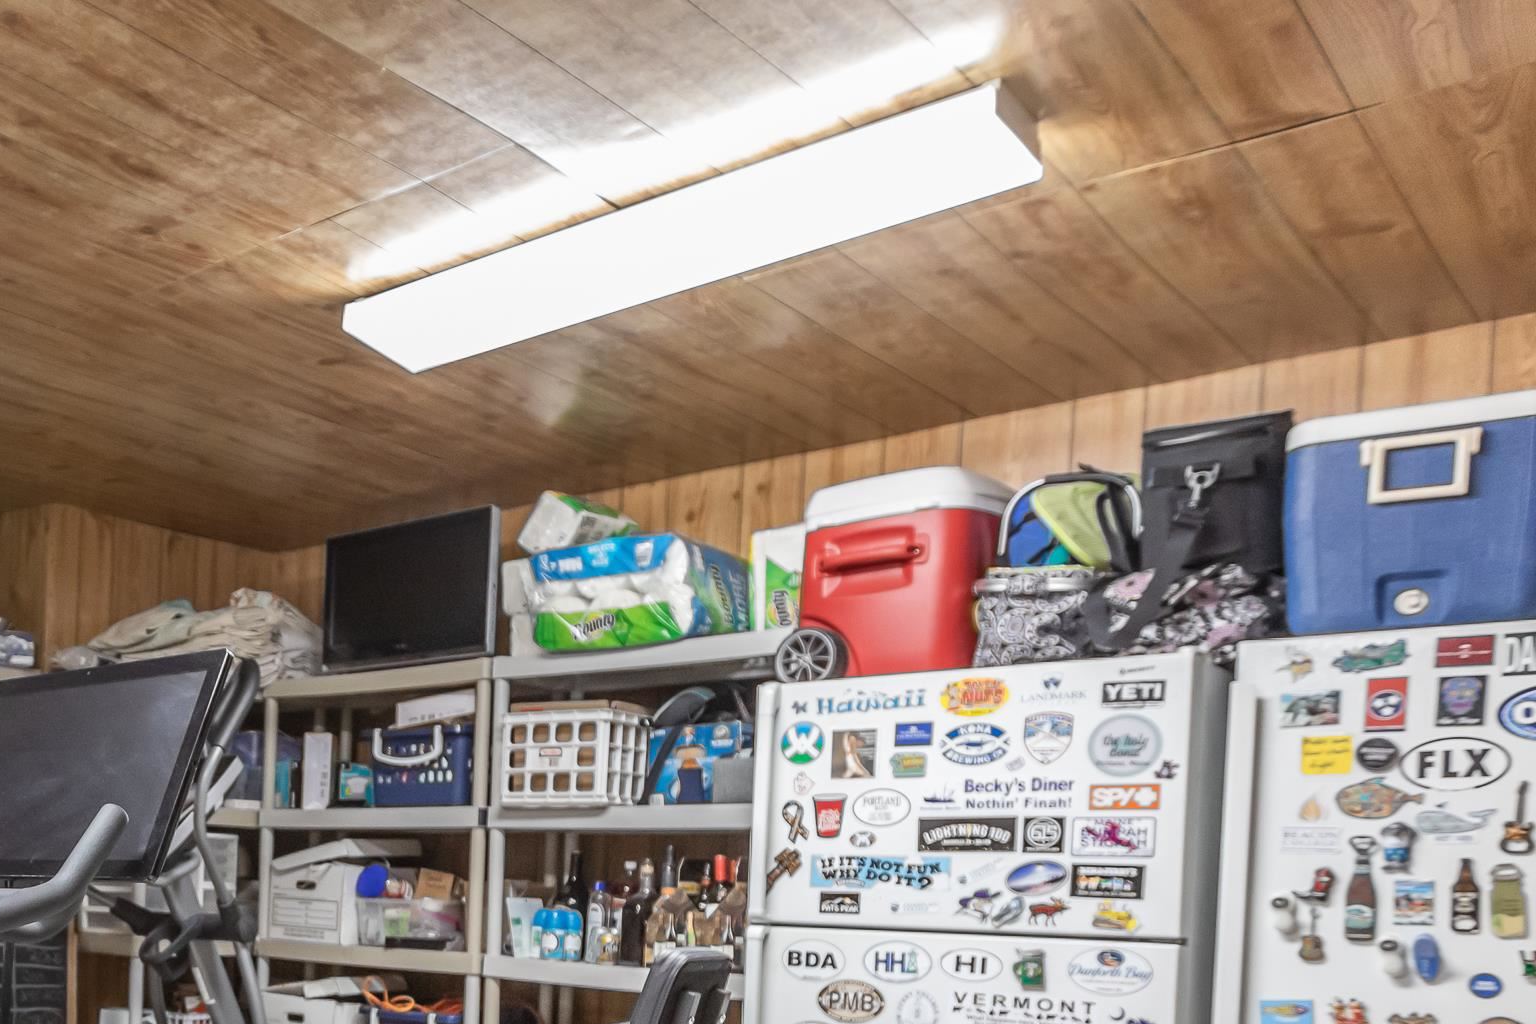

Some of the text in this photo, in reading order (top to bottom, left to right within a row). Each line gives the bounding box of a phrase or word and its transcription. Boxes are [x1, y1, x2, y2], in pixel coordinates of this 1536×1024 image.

[1104, 682, 1162, 701] YETI
[816, 689, 926, 715] Hawaii
[959, 722, 992, 736] KONA
[946, 748, 992, 765] BREWING
[1418, 748, 1491, 779] FLX
[964, 777, 1076, 796] Becky's Diner
[966, 796, 1072, 809] Nothin' Finah!
[922, 822, 1012, 845] LIGHTNING 100
[821, 856, 942, 875] IF IT'S NOT FUN
[822, 868, 861, 880] WHY
[866, 870, 891, 883] DO
[787, 950, 838, 969] BDA
[954, 954, 988, 975] HI
[829, 991, 875, 1014] PMB
[954, 991, 1096, 1014] VERMONT
